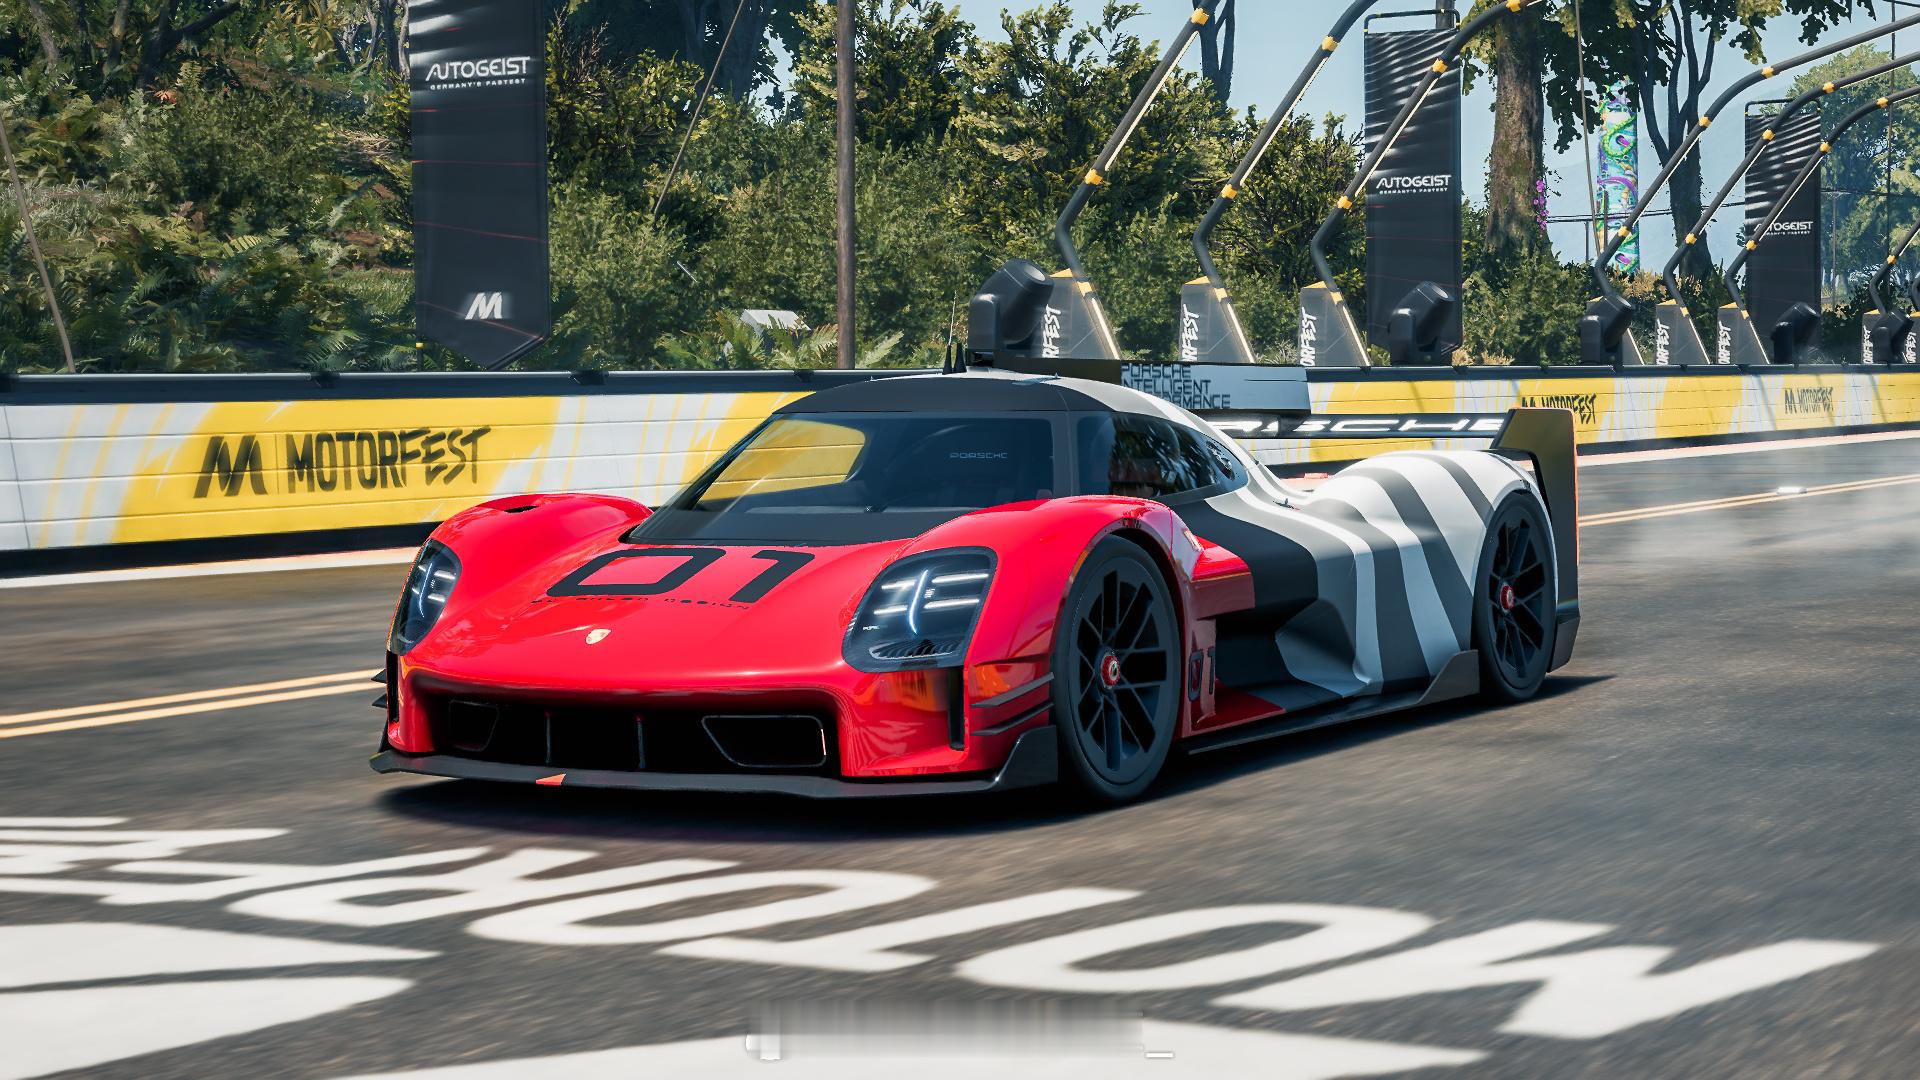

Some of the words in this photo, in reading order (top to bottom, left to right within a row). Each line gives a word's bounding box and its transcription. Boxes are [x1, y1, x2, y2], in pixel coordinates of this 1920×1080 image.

[425, 56, 531, 82] AUTOGEIST
[1376, 174, 1452, 189] AUTOGEIST
[1120, 363, 1191, 379] PORSCHE
[1120, 379, 1212, 396] NTELLIGENT
[286, 425, 491, 494] MOTORFEST
[546, 547, 816, 604] 01
